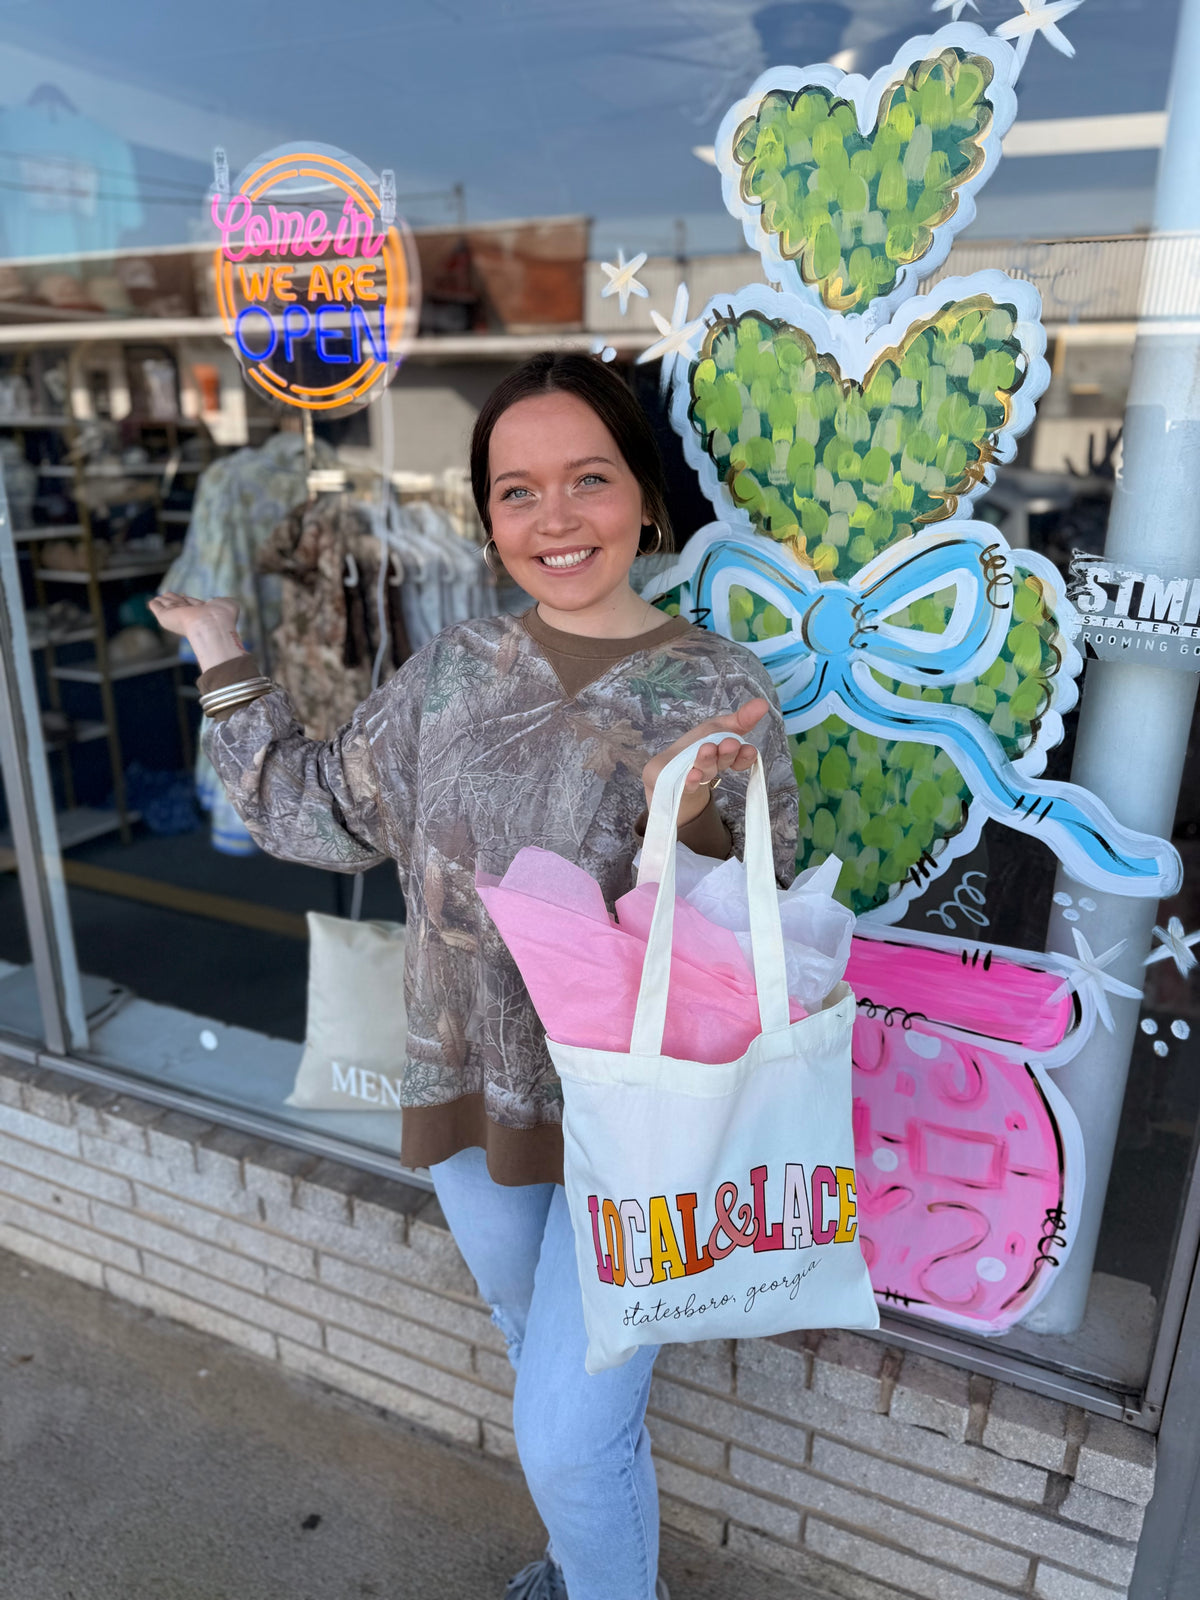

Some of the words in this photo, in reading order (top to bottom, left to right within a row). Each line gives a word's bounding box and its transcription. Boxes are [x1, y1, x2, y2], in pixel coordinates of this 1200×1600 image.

[211, 193, 332, 261] Come
[333, 196, 385, 258] in
[238, 265, 297, 301] WE
[307, 264, 379, 301] ARE
[235, 304, 388, 364] OPEN
[1083, 615, 1199, 638] STATEME
[331, 1061, 402, 1111] MEN
[623, 1293, 737, 1327] statesboro,
[744, 1257, 822, 1313] georgia
